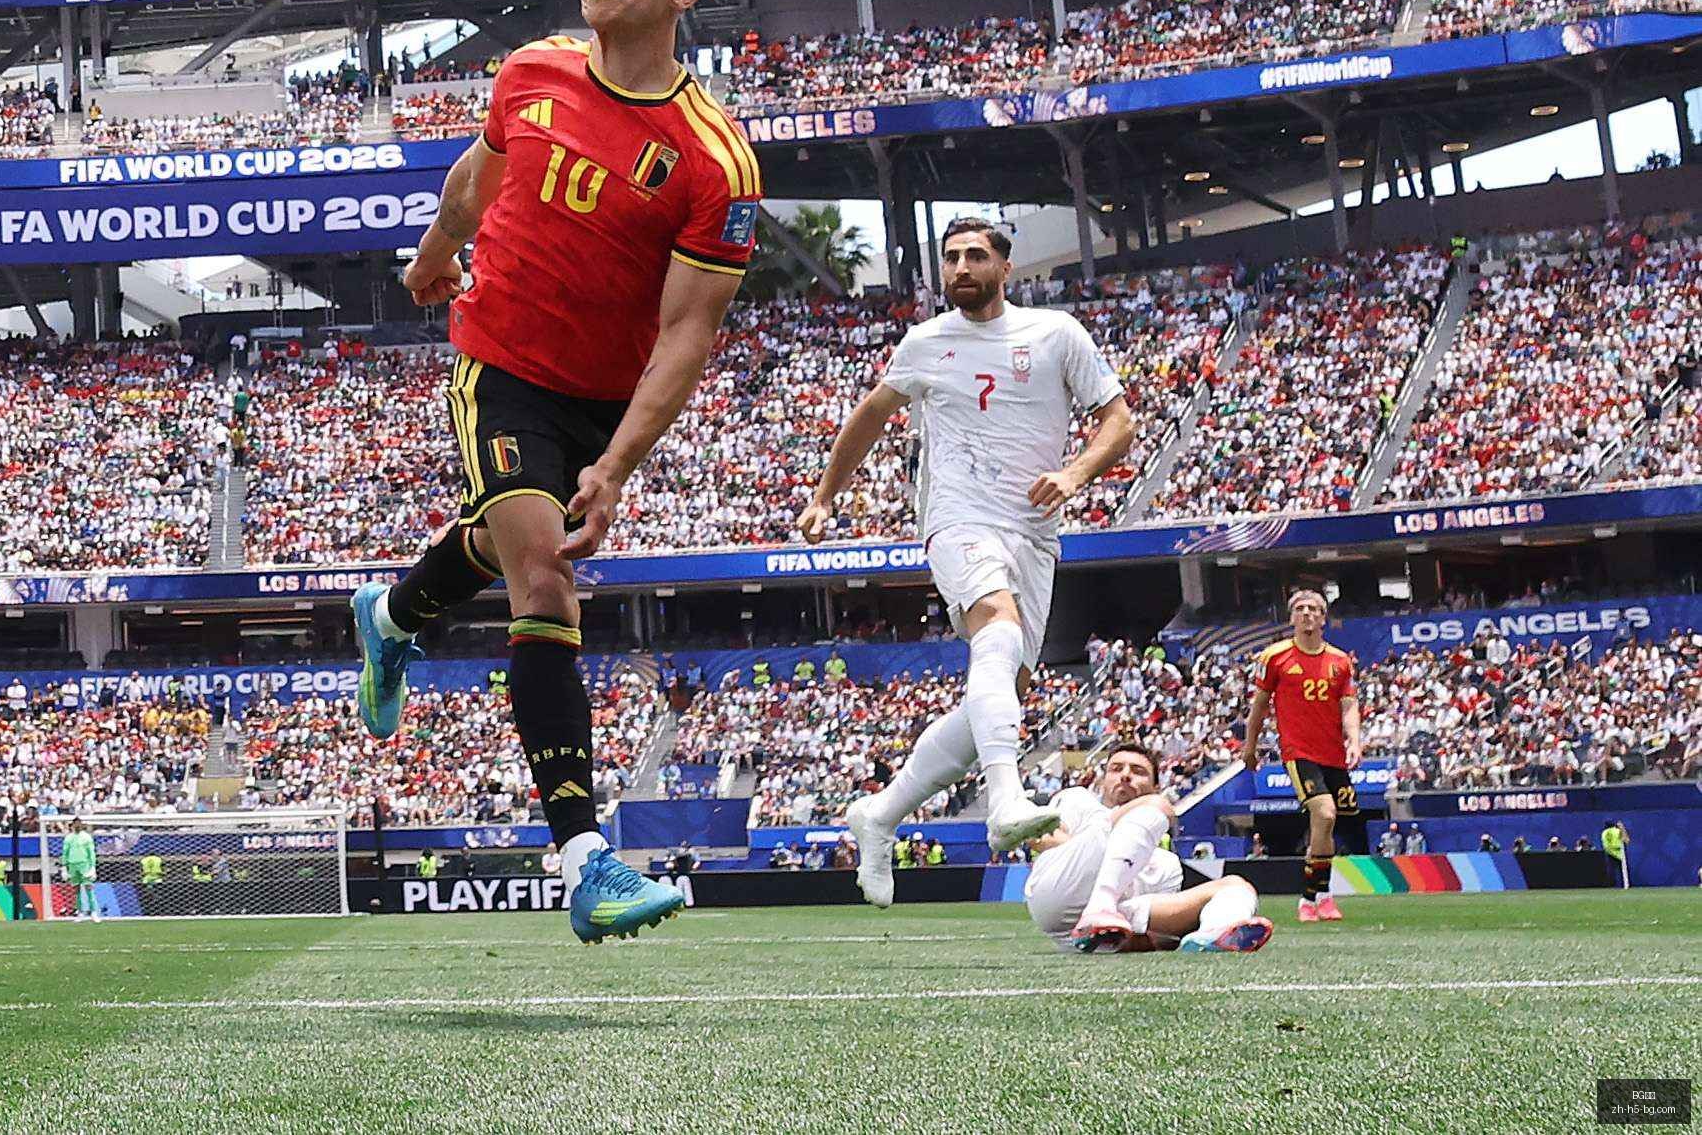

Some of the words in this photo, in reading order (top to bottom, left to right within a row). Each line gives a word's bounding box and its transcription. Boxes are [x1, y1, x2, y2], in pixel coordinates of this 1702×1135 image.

[1260, 56, 1392, 89] #FIFAWorldCup
[59, 159, 123, 184] FIFA
[124, 154, 233, 181] WORLD
[234, 150, 296, 176] CUP
[297, 144, 406, 173] 2026
[540, 143, 609, 214] 10
[57, 204, 220, 242] WORLD
[226, 199, 316, 237] CUP
[322, 191, 440, 232] 202
[975, 374, 996, 411] 7
[1394, 512, 1438, 534] LOS
[1443, 502, 1545, 530] ANGELES
[766, 553, 812, 573] FIFA
[812, 549, 887, 570] WORLD
[258, 574, 300, 592] LOS
[1392, 620, 1465, 644] LOS
[291, 670, 360, 693] 202
[1303, 678, 1329, 701] 22
